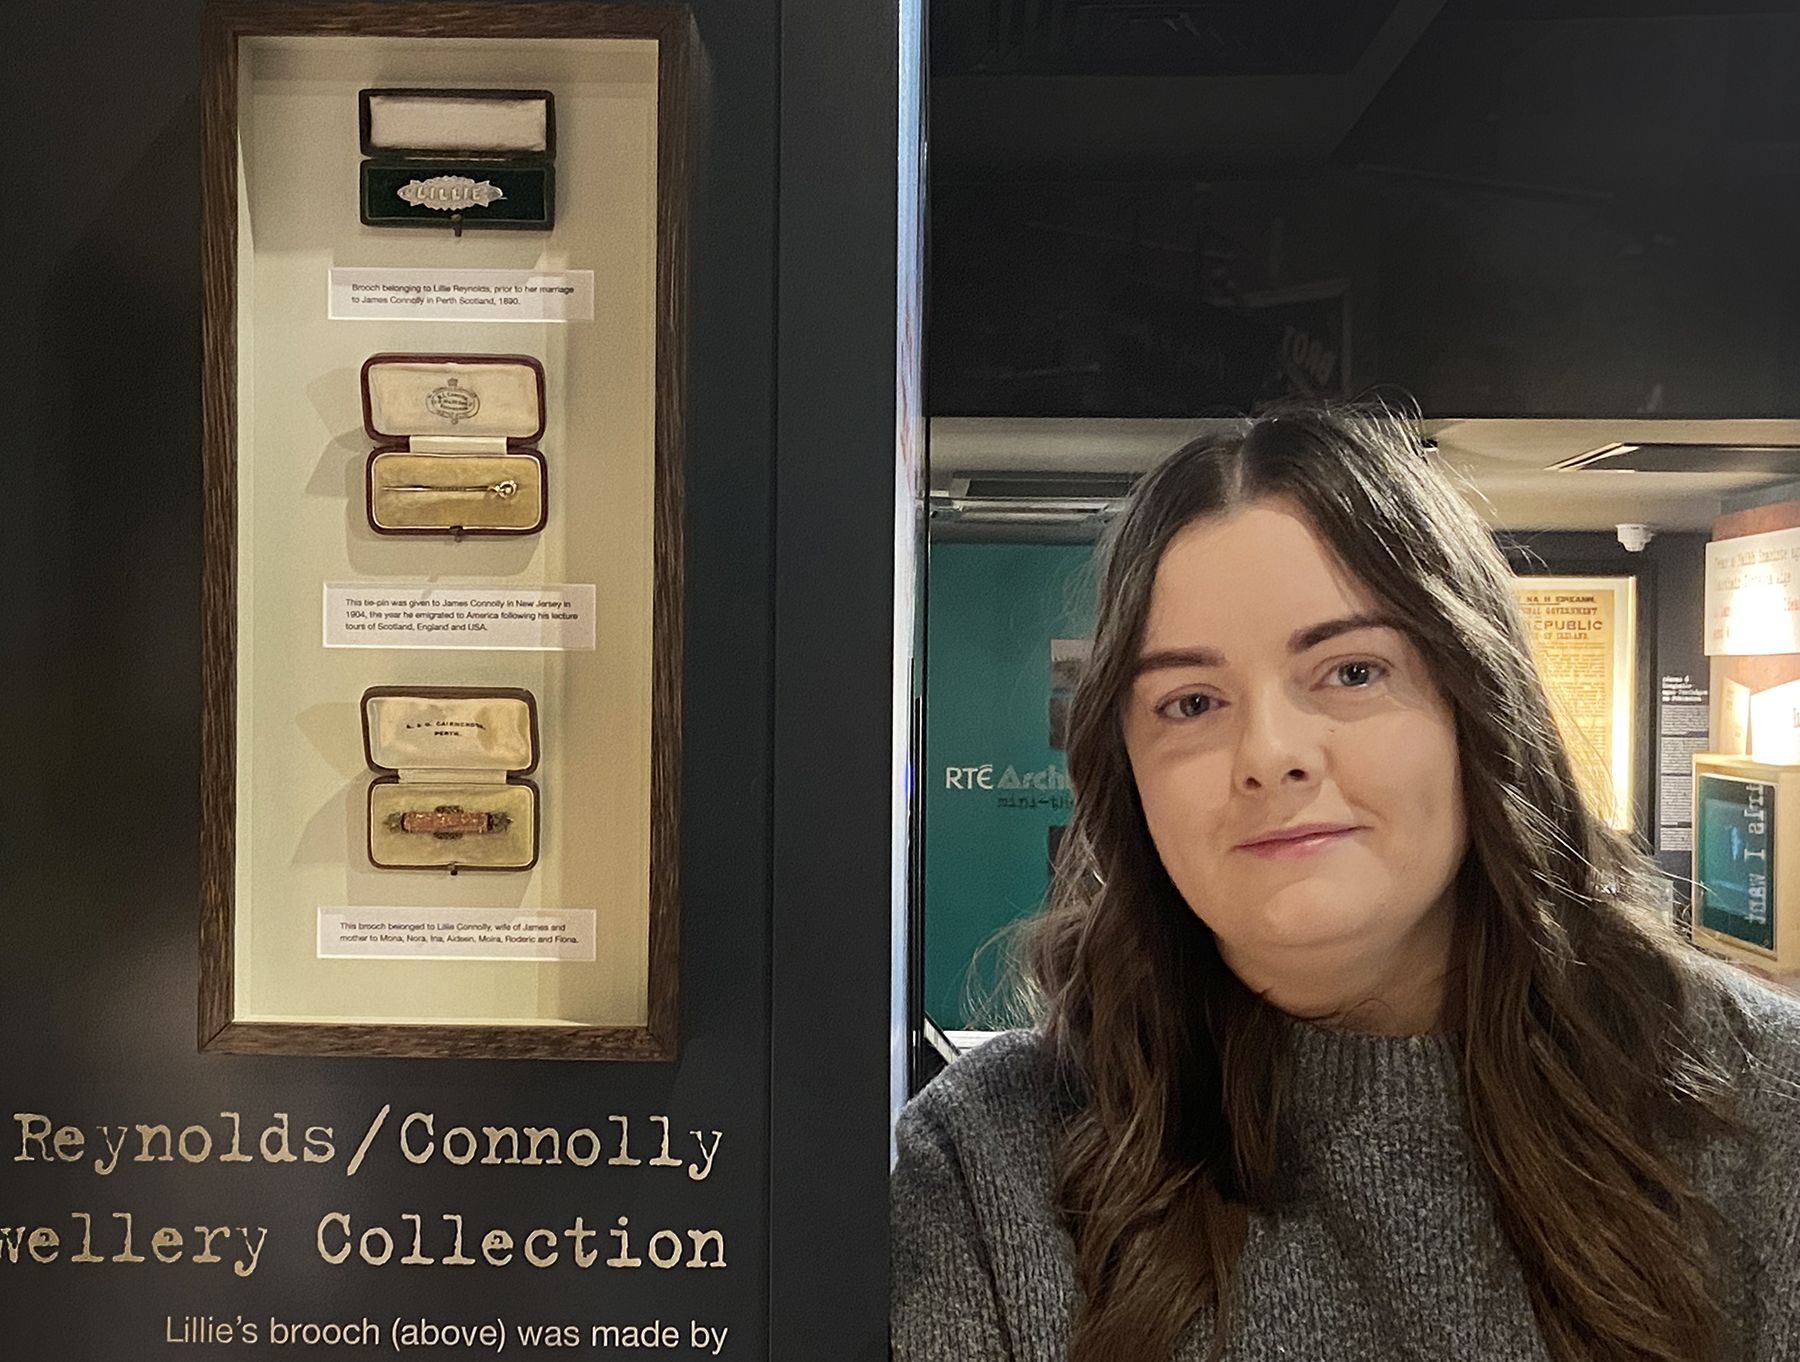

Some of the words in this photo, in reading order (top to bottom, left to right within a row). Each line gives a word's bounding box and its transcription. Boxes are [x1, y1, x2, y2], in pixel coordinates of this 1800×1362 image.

[417, 187, 480, 200] LILLIE
[351, 284, 381, 293] Brooch
[381, 284, 422, 295] belonging
[422, 285, 432, 293] to
[432, 285, 451, 293] Lillie
[493, 286, 513, 295] prior
[514, 286, 523, 294] to
[524, 286, 538, 294] her
[539, 287, 575, 295] marriage
[351, 296, 361, 304] to
[361, 296, 389, 305] James
[389, 296, 425, 306] Connolly
[426, 297, 435, 305] in
[435, 297, 458, 305] Perth
[345, 599, 363, 608] This
[363, 600, 390, 609] tie-pin
[408, 600, 431, 610] given
[431, 600, 441, 608] to
[441, 600, 469, 608] James
[469, 600, 505, 610] Connolly
[506, 600, 515, 608] in
[515, 601, 535, 609] New
[535, 601, 563, 611] Jersey
[563, 601, 572, 609] in
[369, 611, 384, 620] the
[383, 612, 402, 622] year
[403, 612, 414, 620] he
[414, 612, 455, 622] emigrated
[456, 612, 465, 620] to
[465, 612, 500, 620] America
[500, 613, 537, 622] following
[537, 613, 550, 621] his
[551, 613, 579, 621] lecture
[345, 623, 367, 631] tours
[367, 623, 377, 631] of
[416, 623, 450, 634] England
[450, 624, 467, 632] and
[1533, 620, 1603, 631] EPUBLIC
[945, 764, 994, 790] RTÉ
[997, 764, 1070, 790] Arch
[339, 922, 357, 931] This
[357, 923, 387, 931] brooch
[387, 923, 426, 933] belonged
[436, 923, 455, 932] Lillie
[512, 924, 522, 932] of
[522, 924, 550, 932] James
[550, 924, 567, 932] and
[339, 934, 368, 943] mother
[369, 934, 379, 943] to
[406, 935, 429, 944] Nora,
[537, 936, 553, 944] and
[13, 1103, 723, 1181] Reynolds/Connolly
[317, 1212, 727, 1269] Collection
[270, 1317, 380, 1345] brooch
[392, 1317, 506, 1352] (above)
[517, 1325, 580, 1348] was
[592, 1320, 680, 1348] made
[691, 1320, 728, 1355] by
